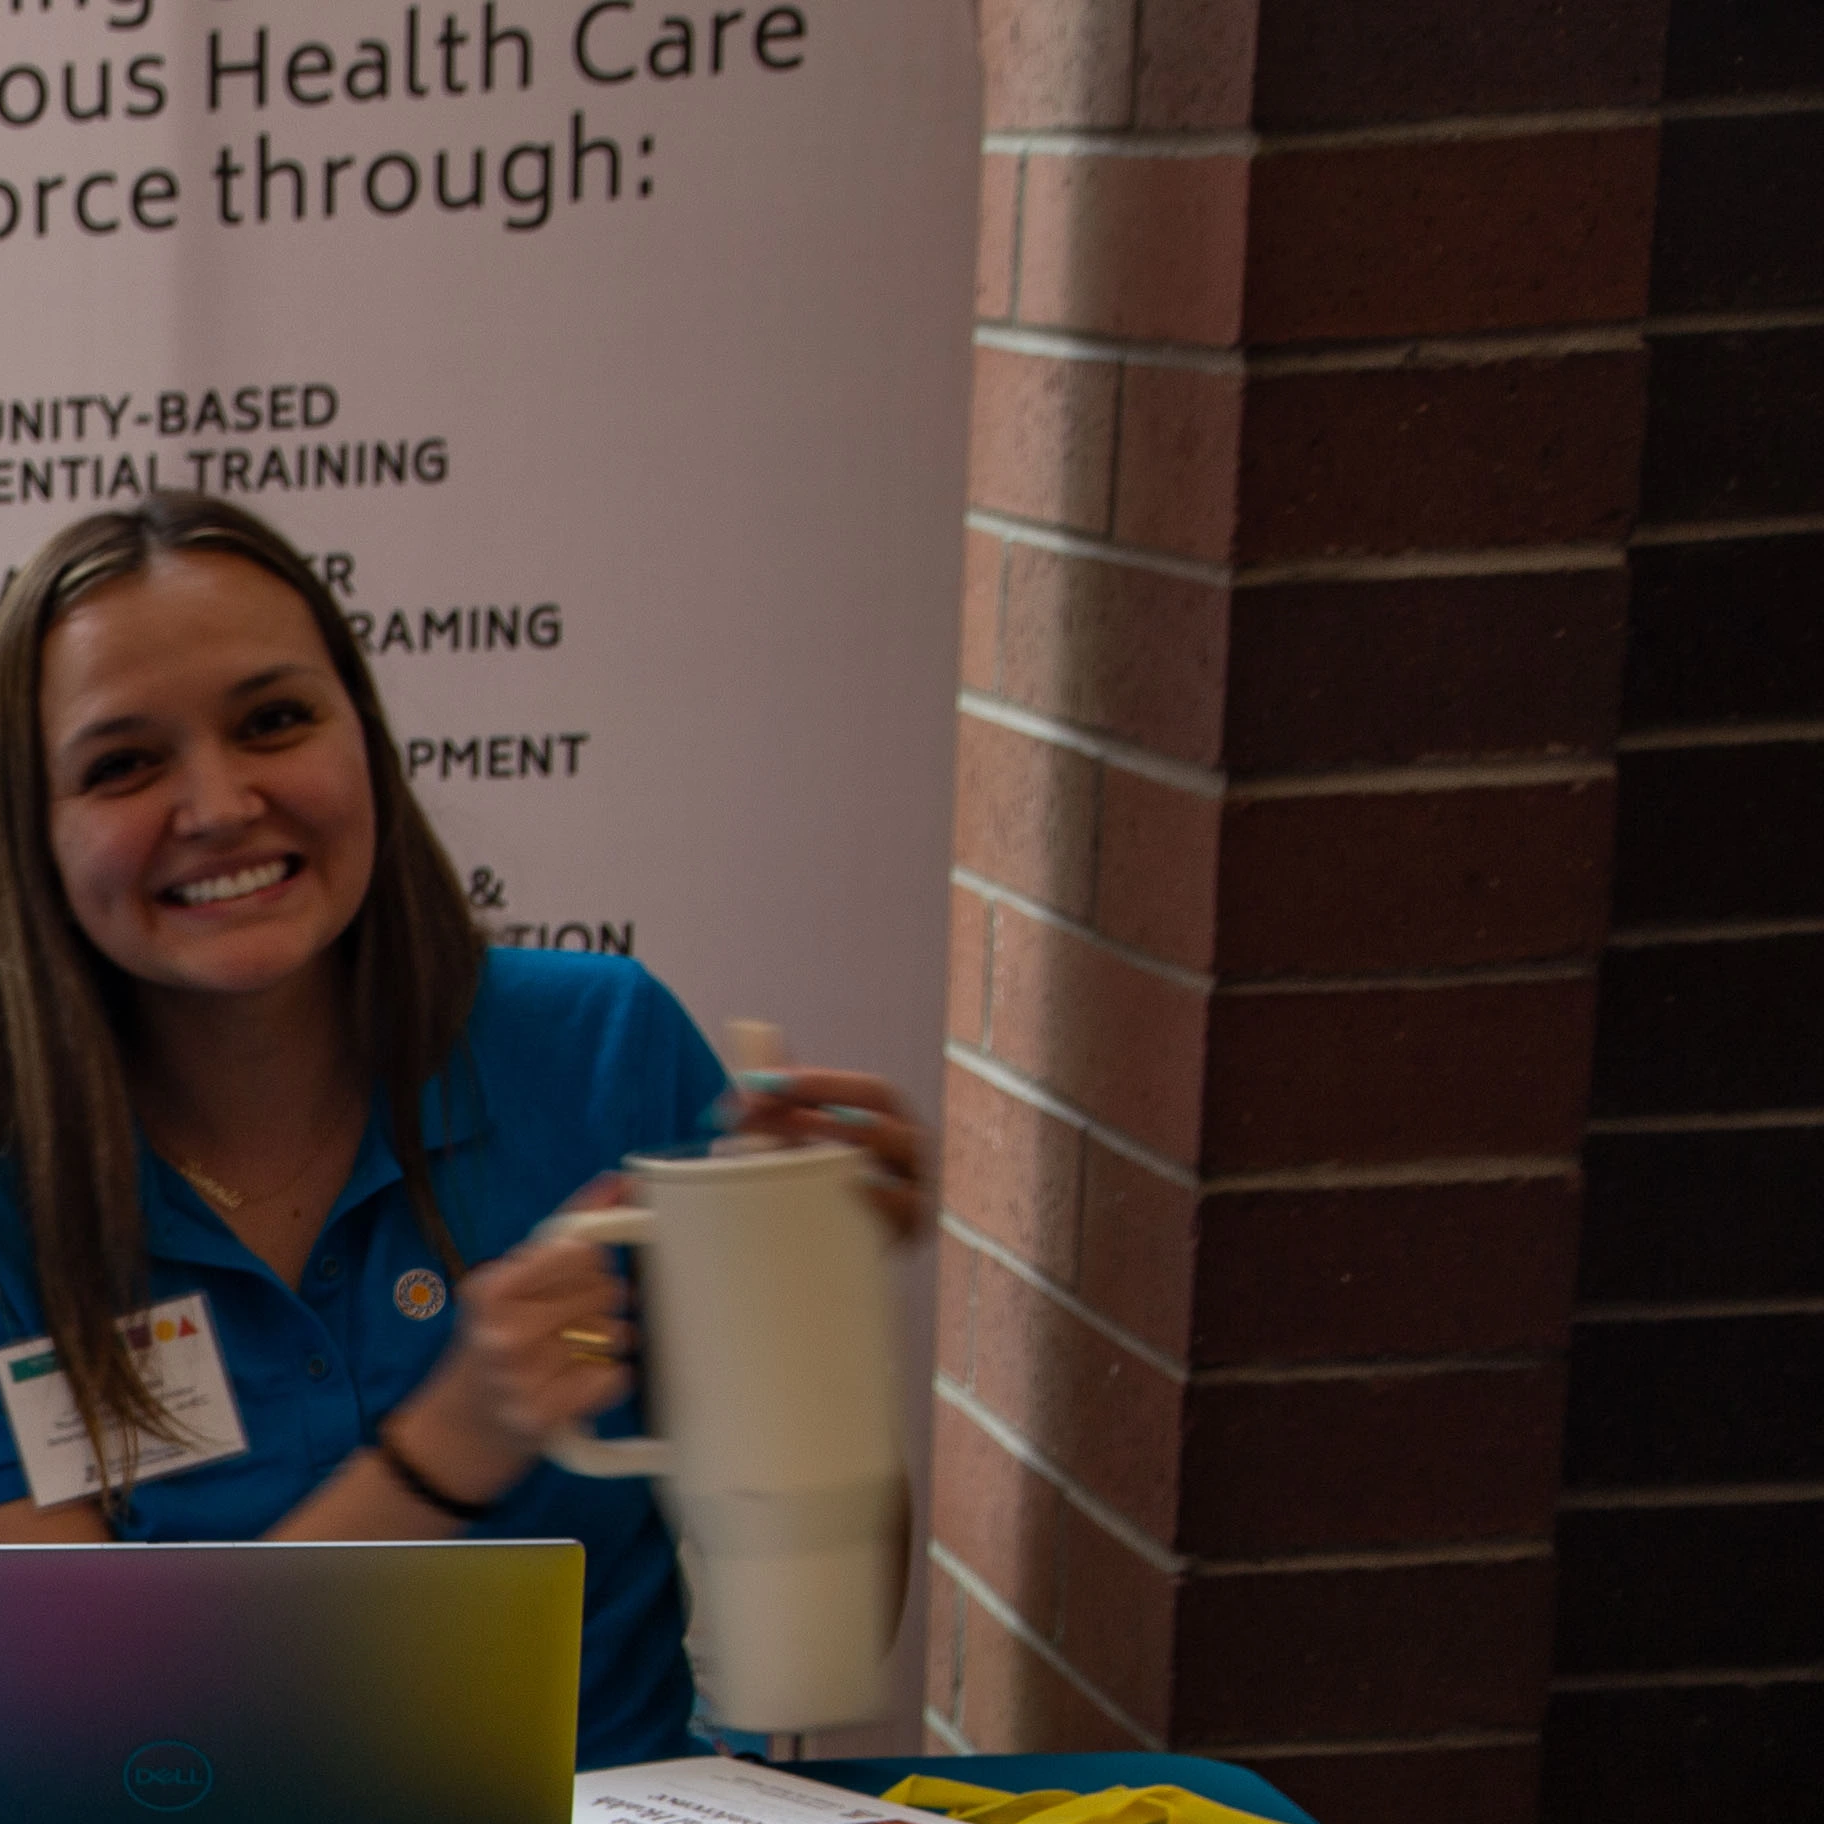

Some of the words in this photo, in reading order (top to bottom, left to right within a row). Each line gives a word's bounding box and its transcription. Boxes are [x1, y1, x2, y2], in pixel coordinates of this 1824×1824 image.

[207, 1, 534, 112] Health
[573, 0, 807, 86] Care
[212, 109, 654, 233] through:
[186, 437, 450, 496] TRAINING
[467, 865, 506, 909] &
